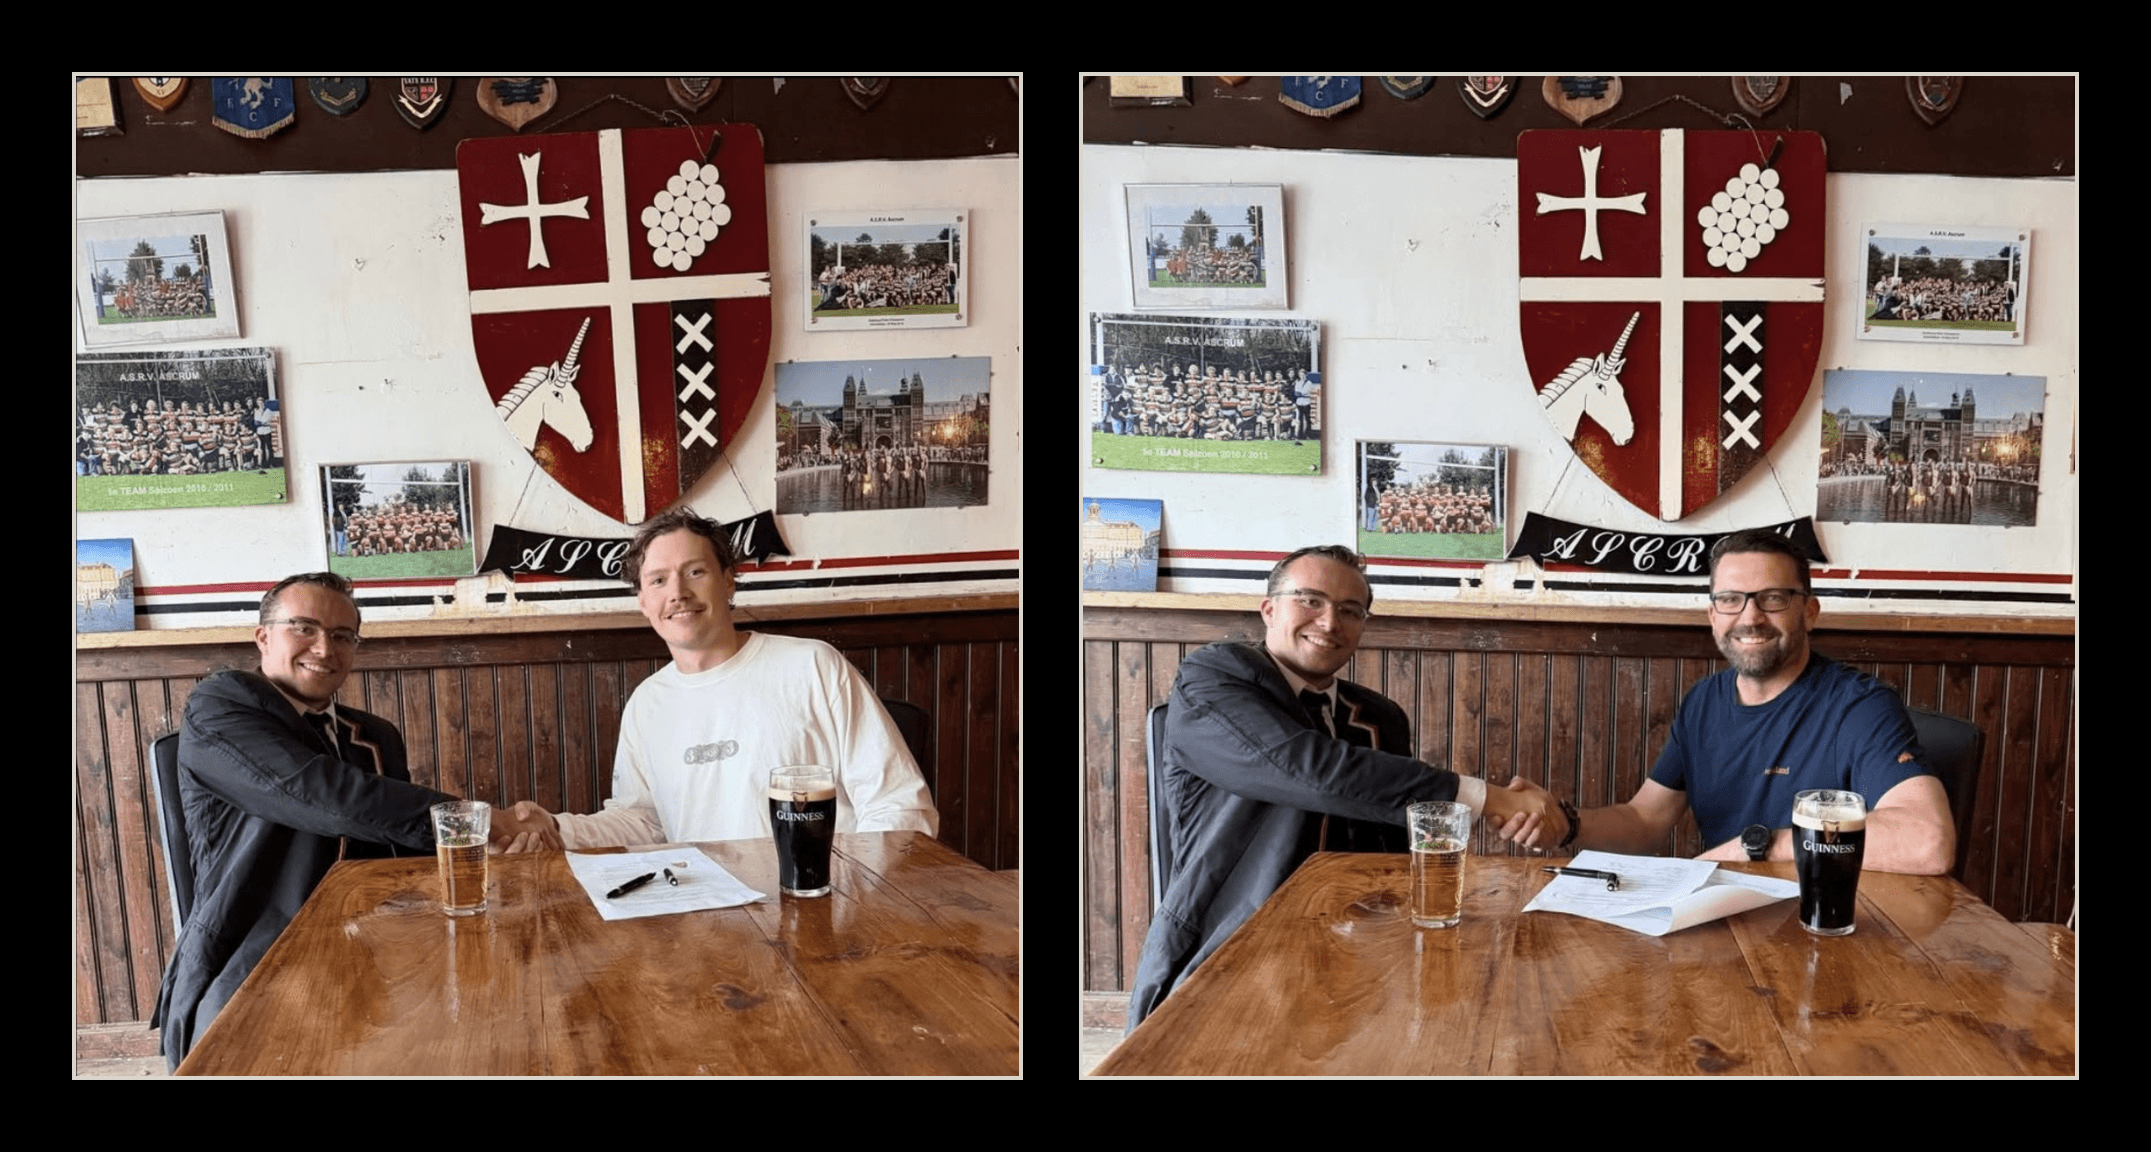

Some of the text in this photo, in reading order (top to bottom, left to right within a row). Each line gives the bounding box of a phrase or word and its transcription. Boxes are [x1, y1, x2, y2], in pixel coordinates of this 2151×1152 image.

[249, 111, 258, 122] C
[1203, 337, 1245, 347] ASCRUM
[159, 371, 200, 381] ASCRUM
[1155, 448, 1181, 457] TEAM
[121, 486, 146, 495] TEAM
[510, 518, 757, 577] ASCM
[1541, 523, 1797, 573] ASCR
[776, 810, 825, 822] GUINNESS
[1802, 839, 1855, 853] GUINNESS
